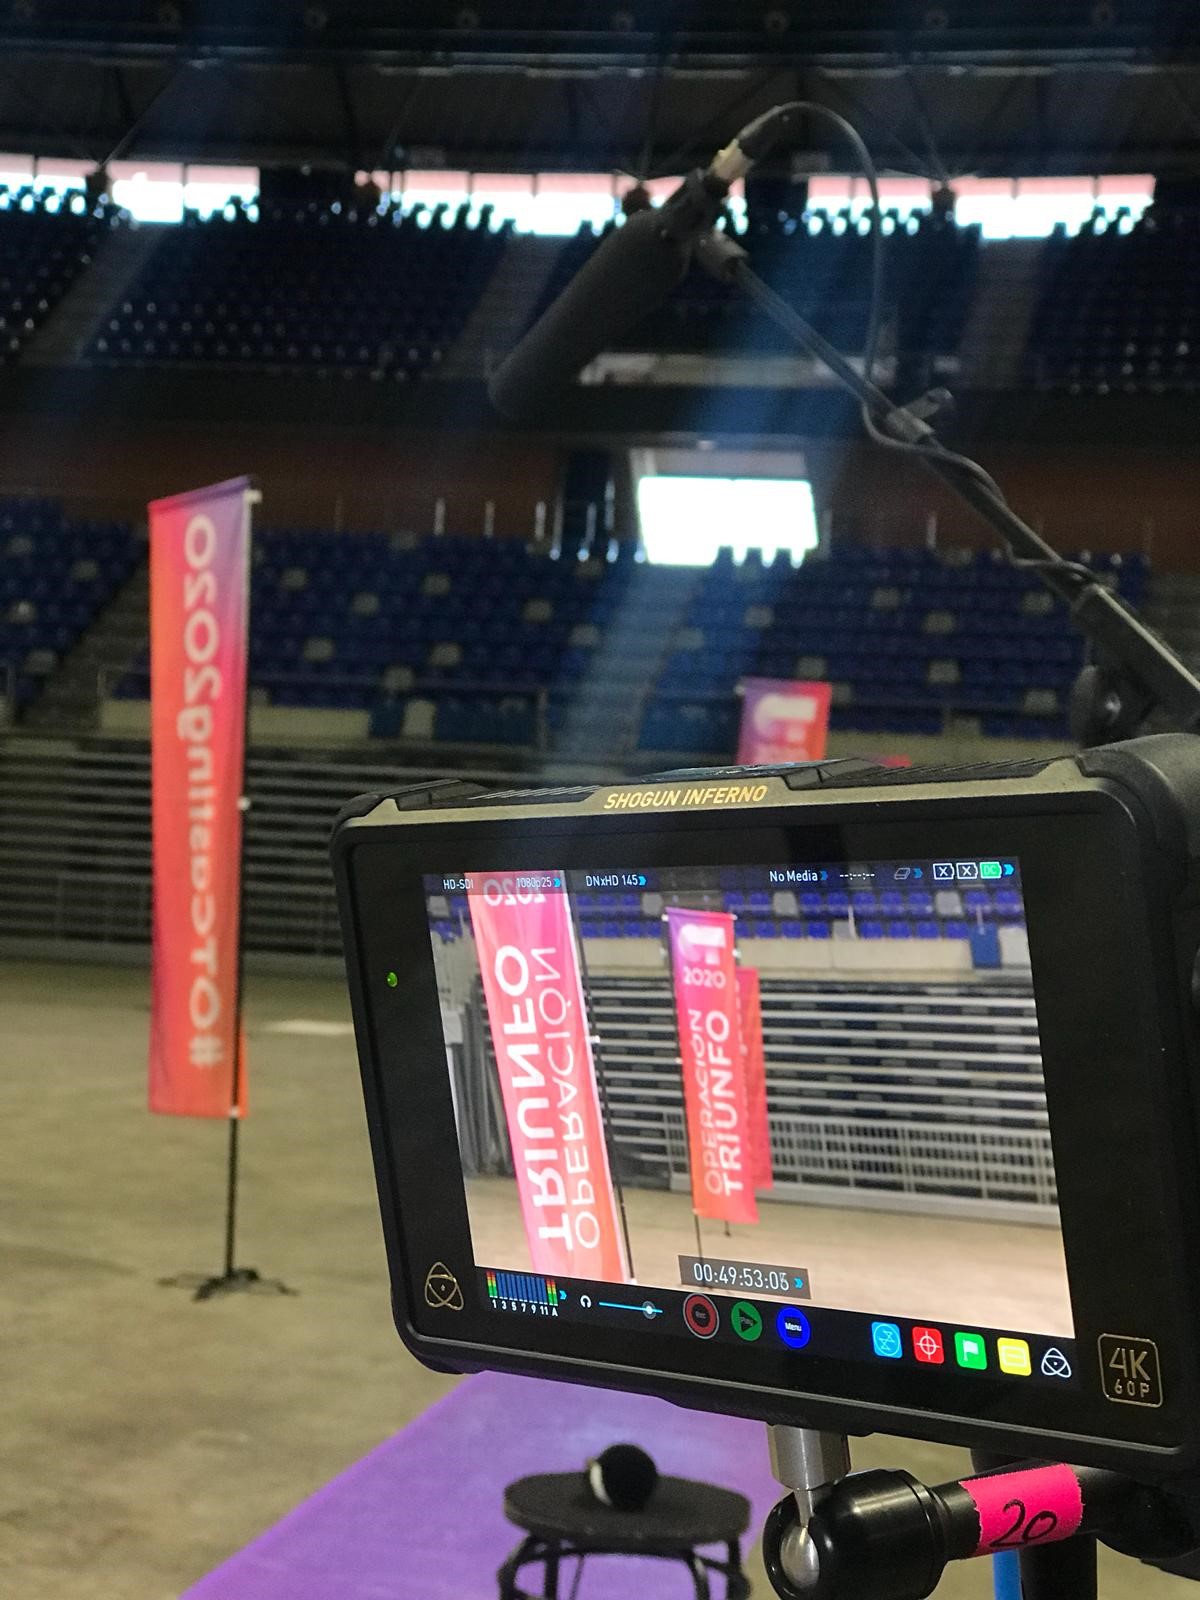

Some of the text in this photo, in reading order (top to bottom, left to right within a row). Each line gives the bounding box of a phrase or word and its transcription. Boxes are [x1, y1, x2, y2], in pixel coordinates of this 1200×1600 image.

[603, 785, 769, 809] SHOGUN INFERNO
[443, 878, 474, 890] HD-SDI
[516, 876, 552, 889] 1080p25
[585, 874, 638, 887] DNxHD 145
[769, 870, 818, 882] No Media
[683, 966, 726, 989] 2020
[705, 1010, 744, 1197] TRIUNFO
[502, 1301, 507, 1310] 3
[512, 1302, 517, 1311] 5
[521, 1303, 527, 1312] 7
[531, 1304, 537, 1314] 9
[540, 1306, 549, 1315] 11
[552, 1307, 558, 1316] A
[784, 1321, 803, 1332] Menu
[1109, 1347, 1151, 1381] 4K
[1113, 1380, 1151, 1398] 60P
[989, 1499, 1058, 1548] 20
